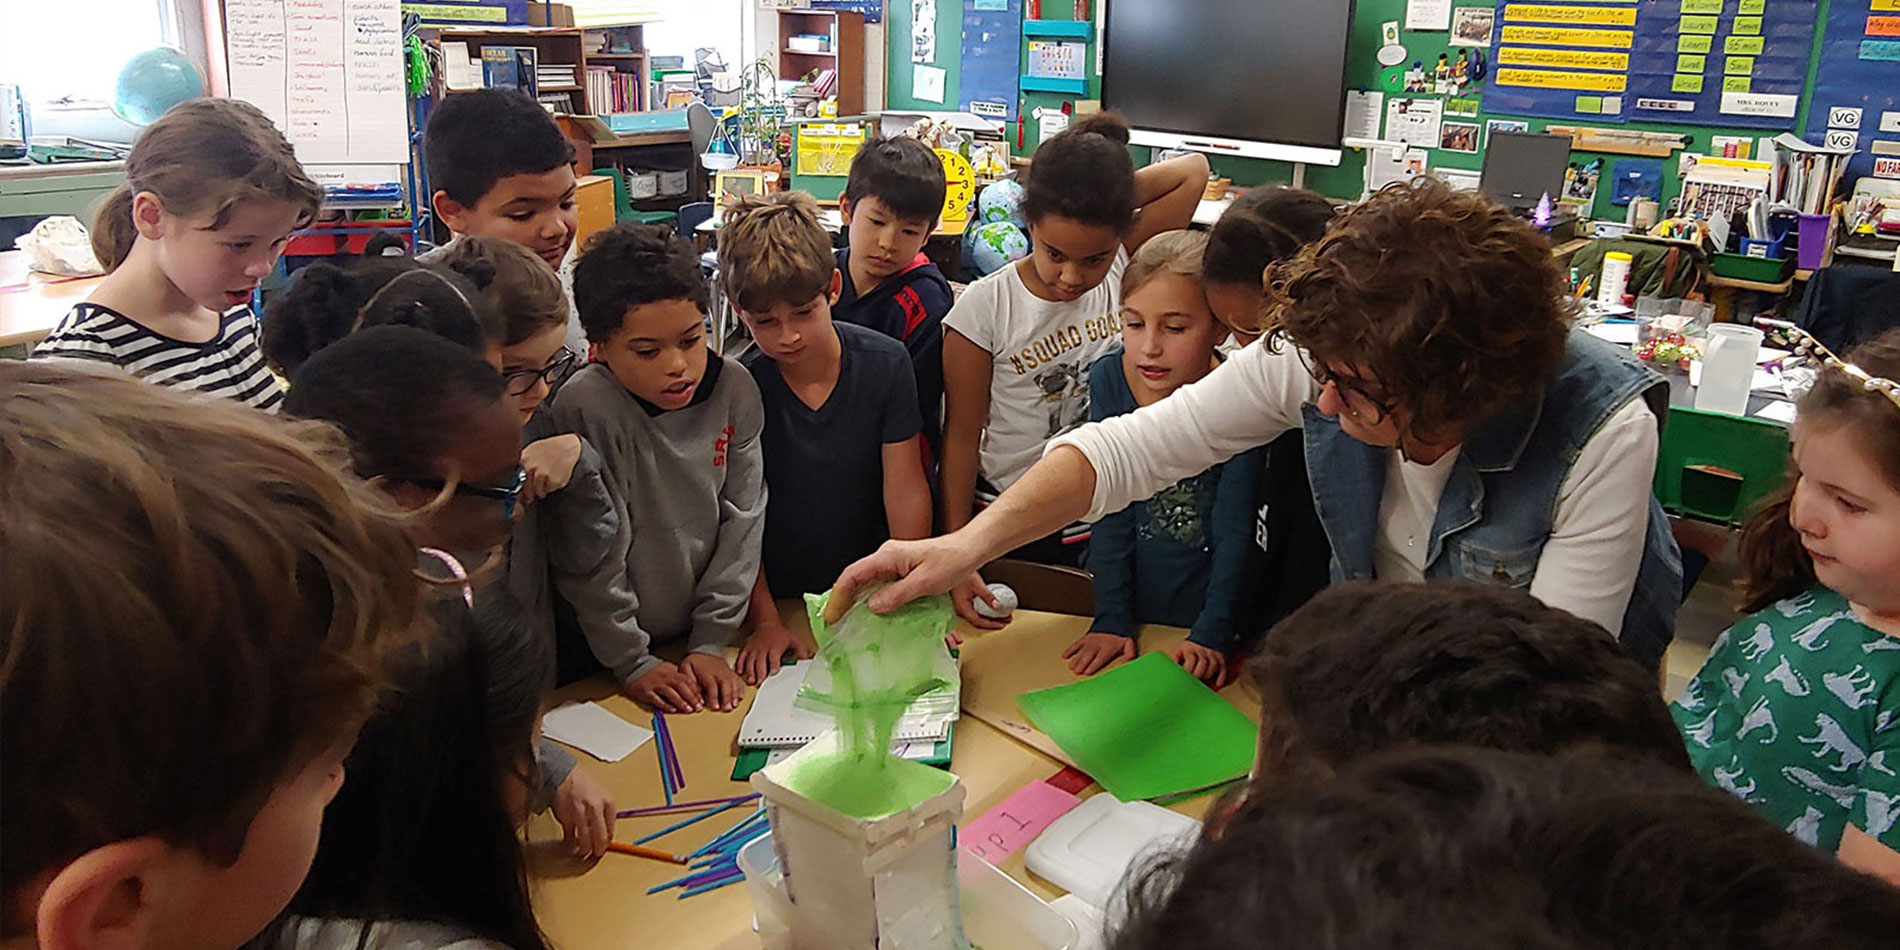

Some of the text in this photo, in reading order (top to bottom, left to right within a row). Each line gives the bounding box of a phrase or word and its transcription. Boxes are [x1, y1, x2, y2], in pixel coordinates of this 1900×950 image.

[1835, 113, 1855, 124] VG
[1831, 135, 1851, 147] VG
[950, 158, 955, 167] 1
[958, 166, 965, 176] 2
[962, 180, 969, 189] 3
[957, 192, 964, 201] 4
[948, 200, 955, 210] 5
[1009, 325, 1082, 375] #SQUAD
